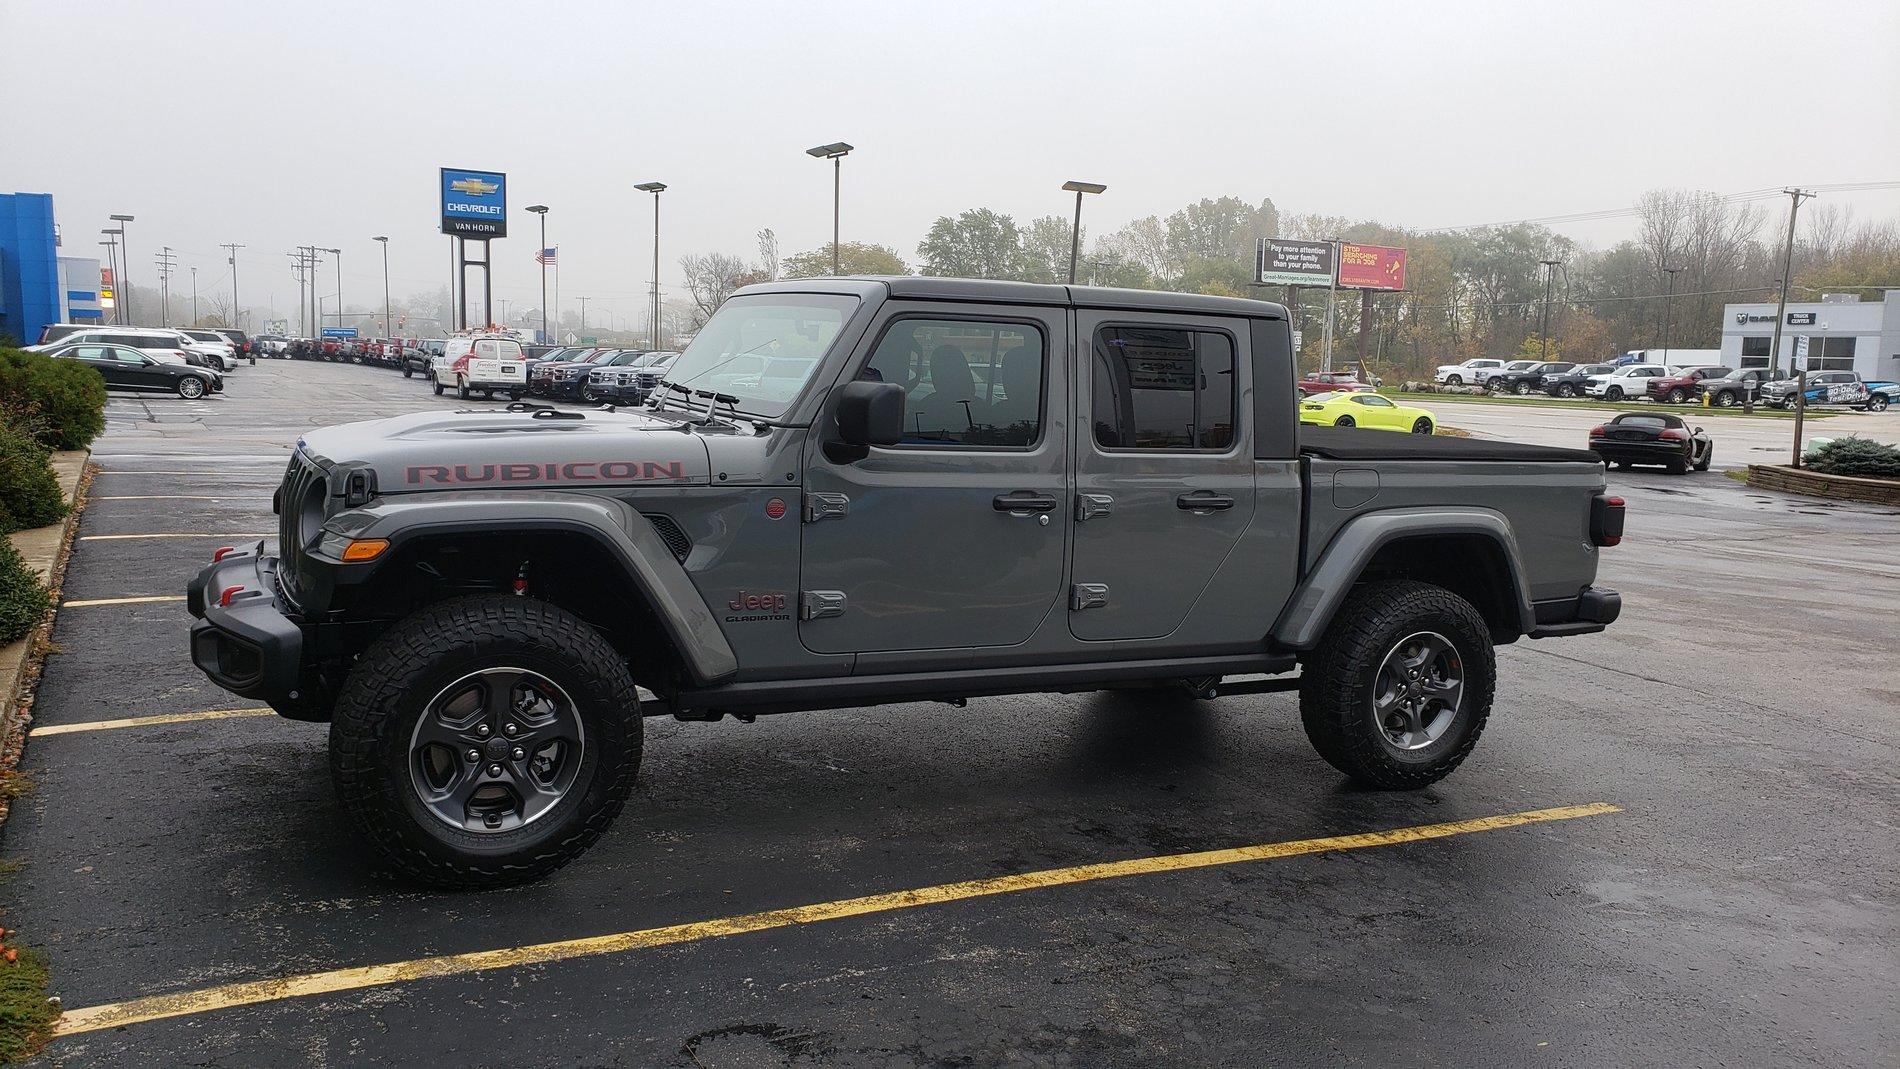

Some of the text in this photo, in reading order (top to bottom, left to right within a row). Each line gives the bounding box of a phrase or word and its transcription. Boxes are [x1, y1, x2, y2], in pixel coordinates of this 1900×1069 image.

[447, 203, 501, 214] CHEVROLET
[455, 222, 496, 232] VAN HORN
[1270, 244, 1282, 253] Pay
[1300, 246, 1326, 255] attention
[1286, 254, 1300, 262] your
[1300, 254, 1319, 263] family
[1343, 252, 1378, 260] SEARCHING
[1302, 262, 1322, 270] phone.
[406, 460, 684, 485] RUBICON
[729, 590, 786, 613] Jeep
[725, 614, 790, 622] GLADIATOR
